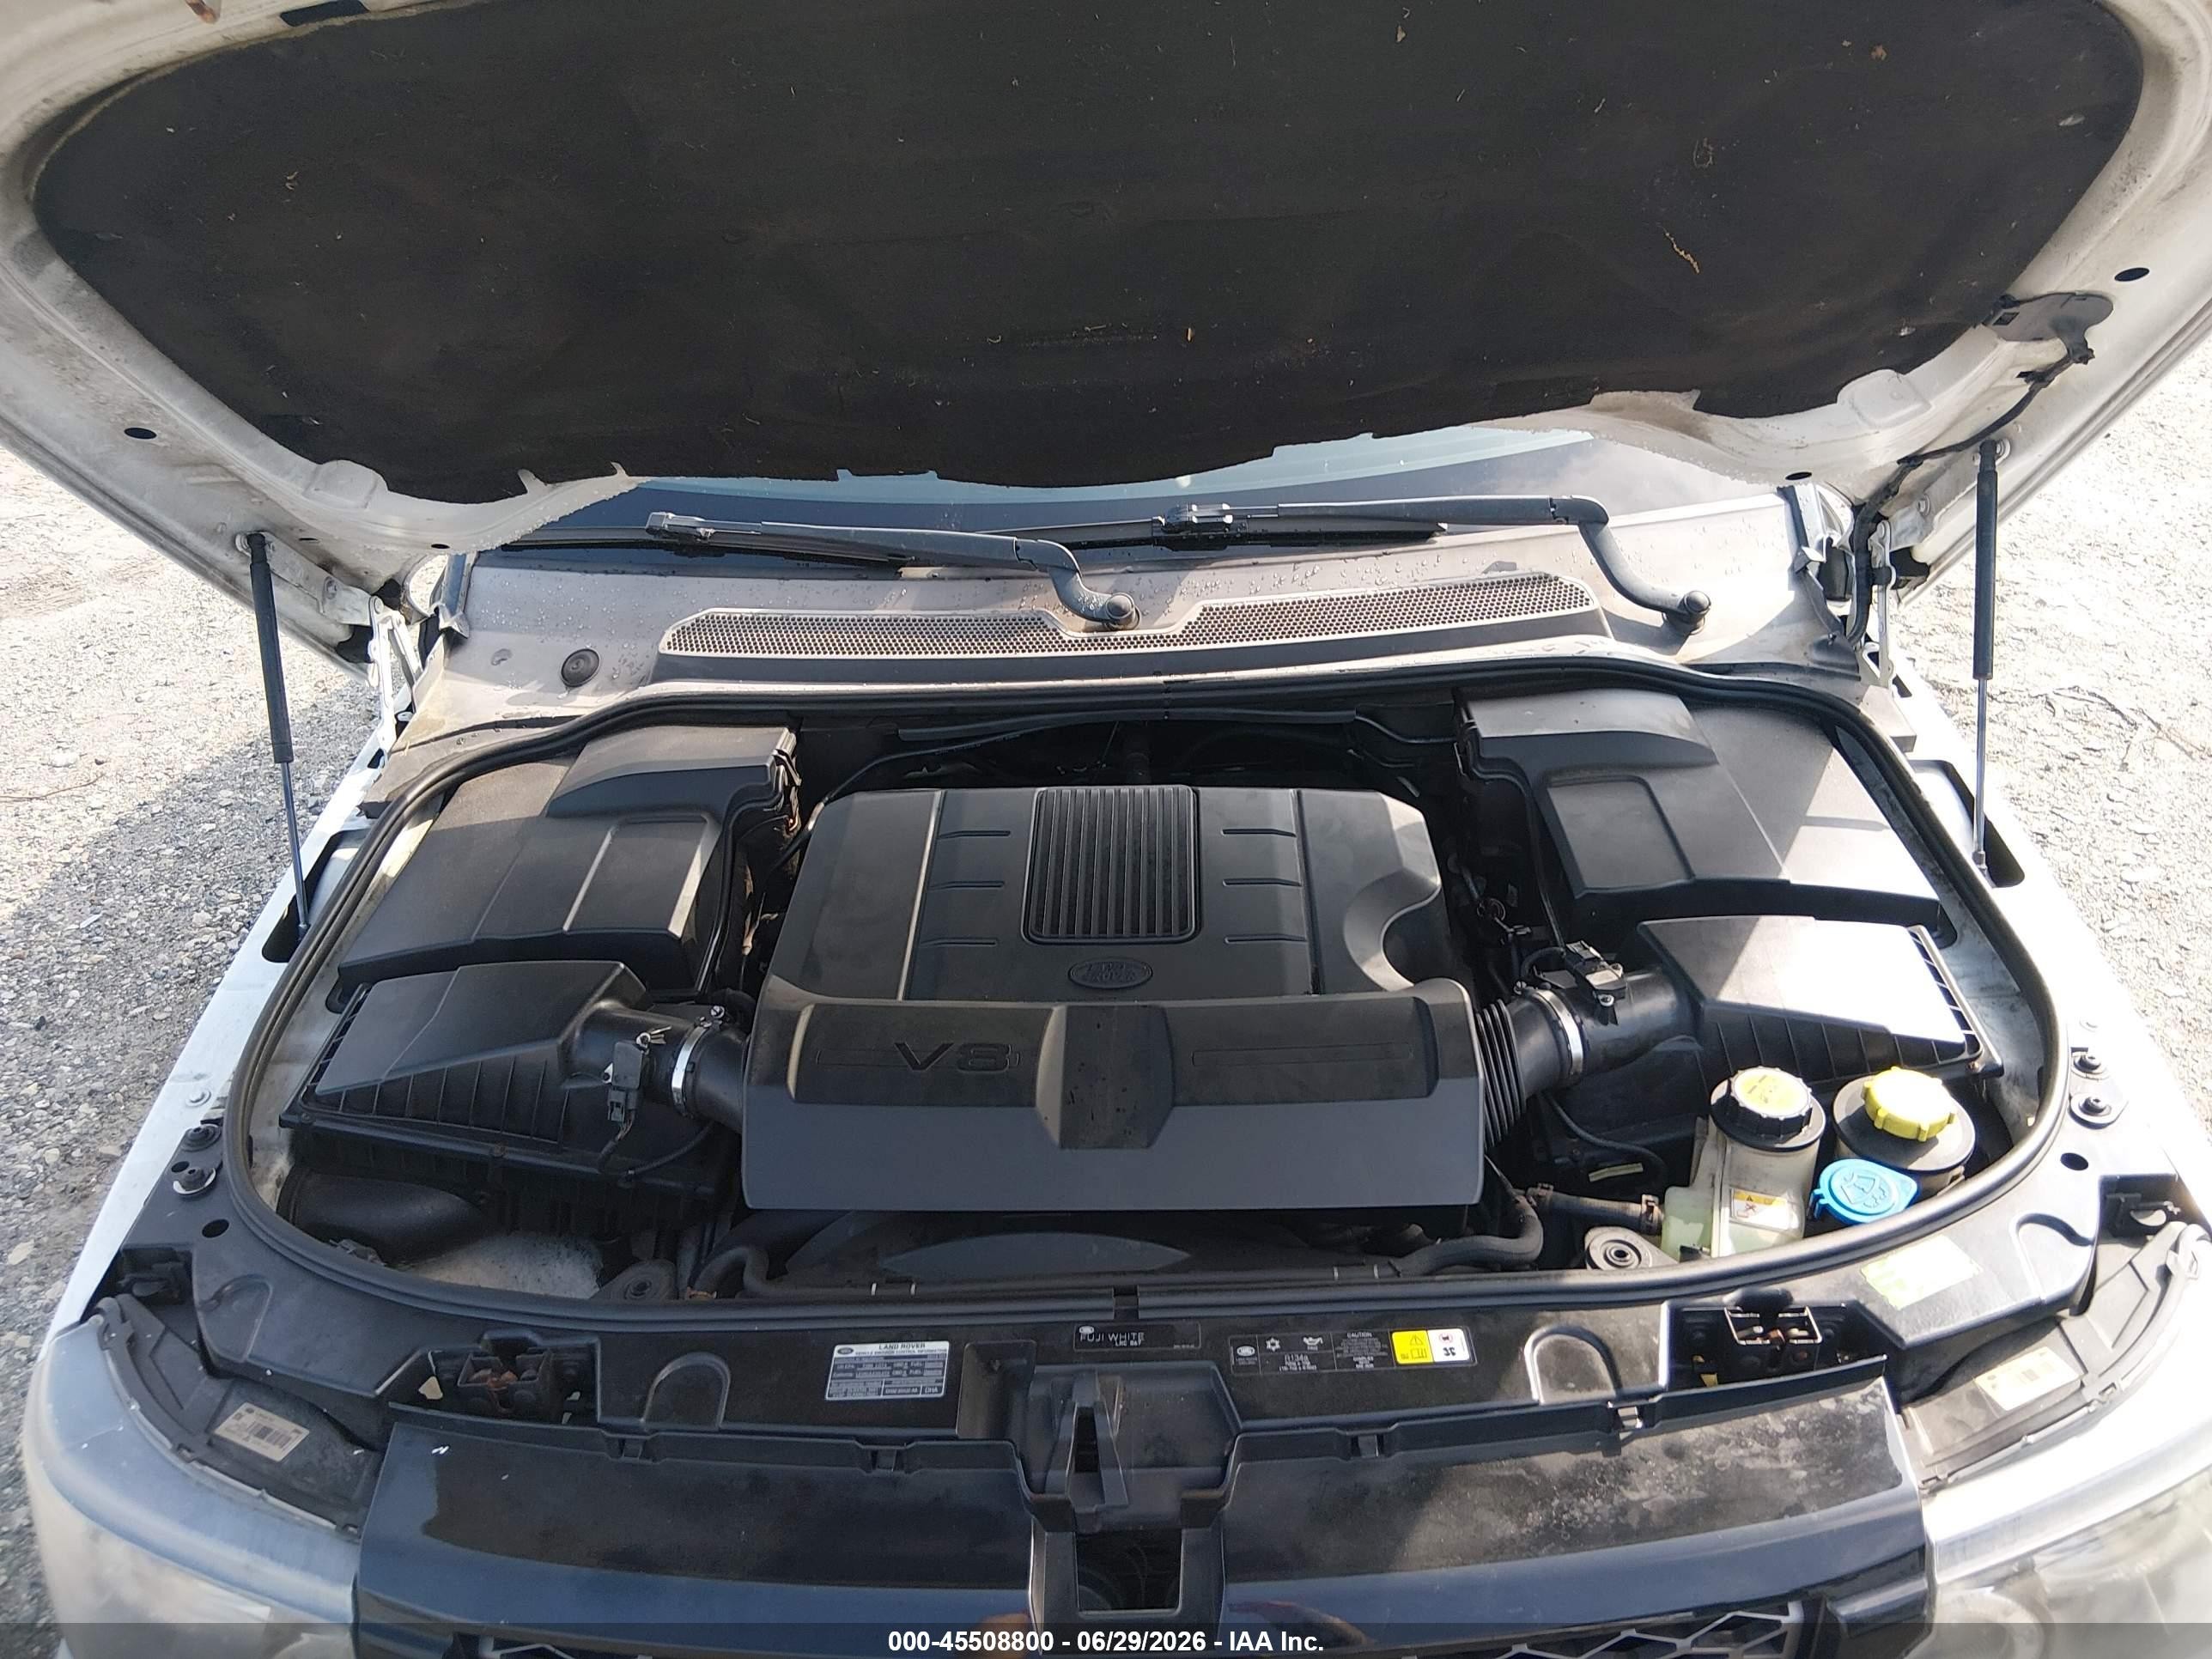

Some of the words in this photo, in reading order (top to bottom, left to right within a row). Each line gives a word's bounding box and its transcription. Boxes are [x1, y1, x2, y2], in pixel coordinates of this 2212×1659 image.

[894, 1042, 1010, 1073] V8
[1079, 1332, 1104, 1342] FUJI
[1108, 1332, 1145, 1342] WHITE
